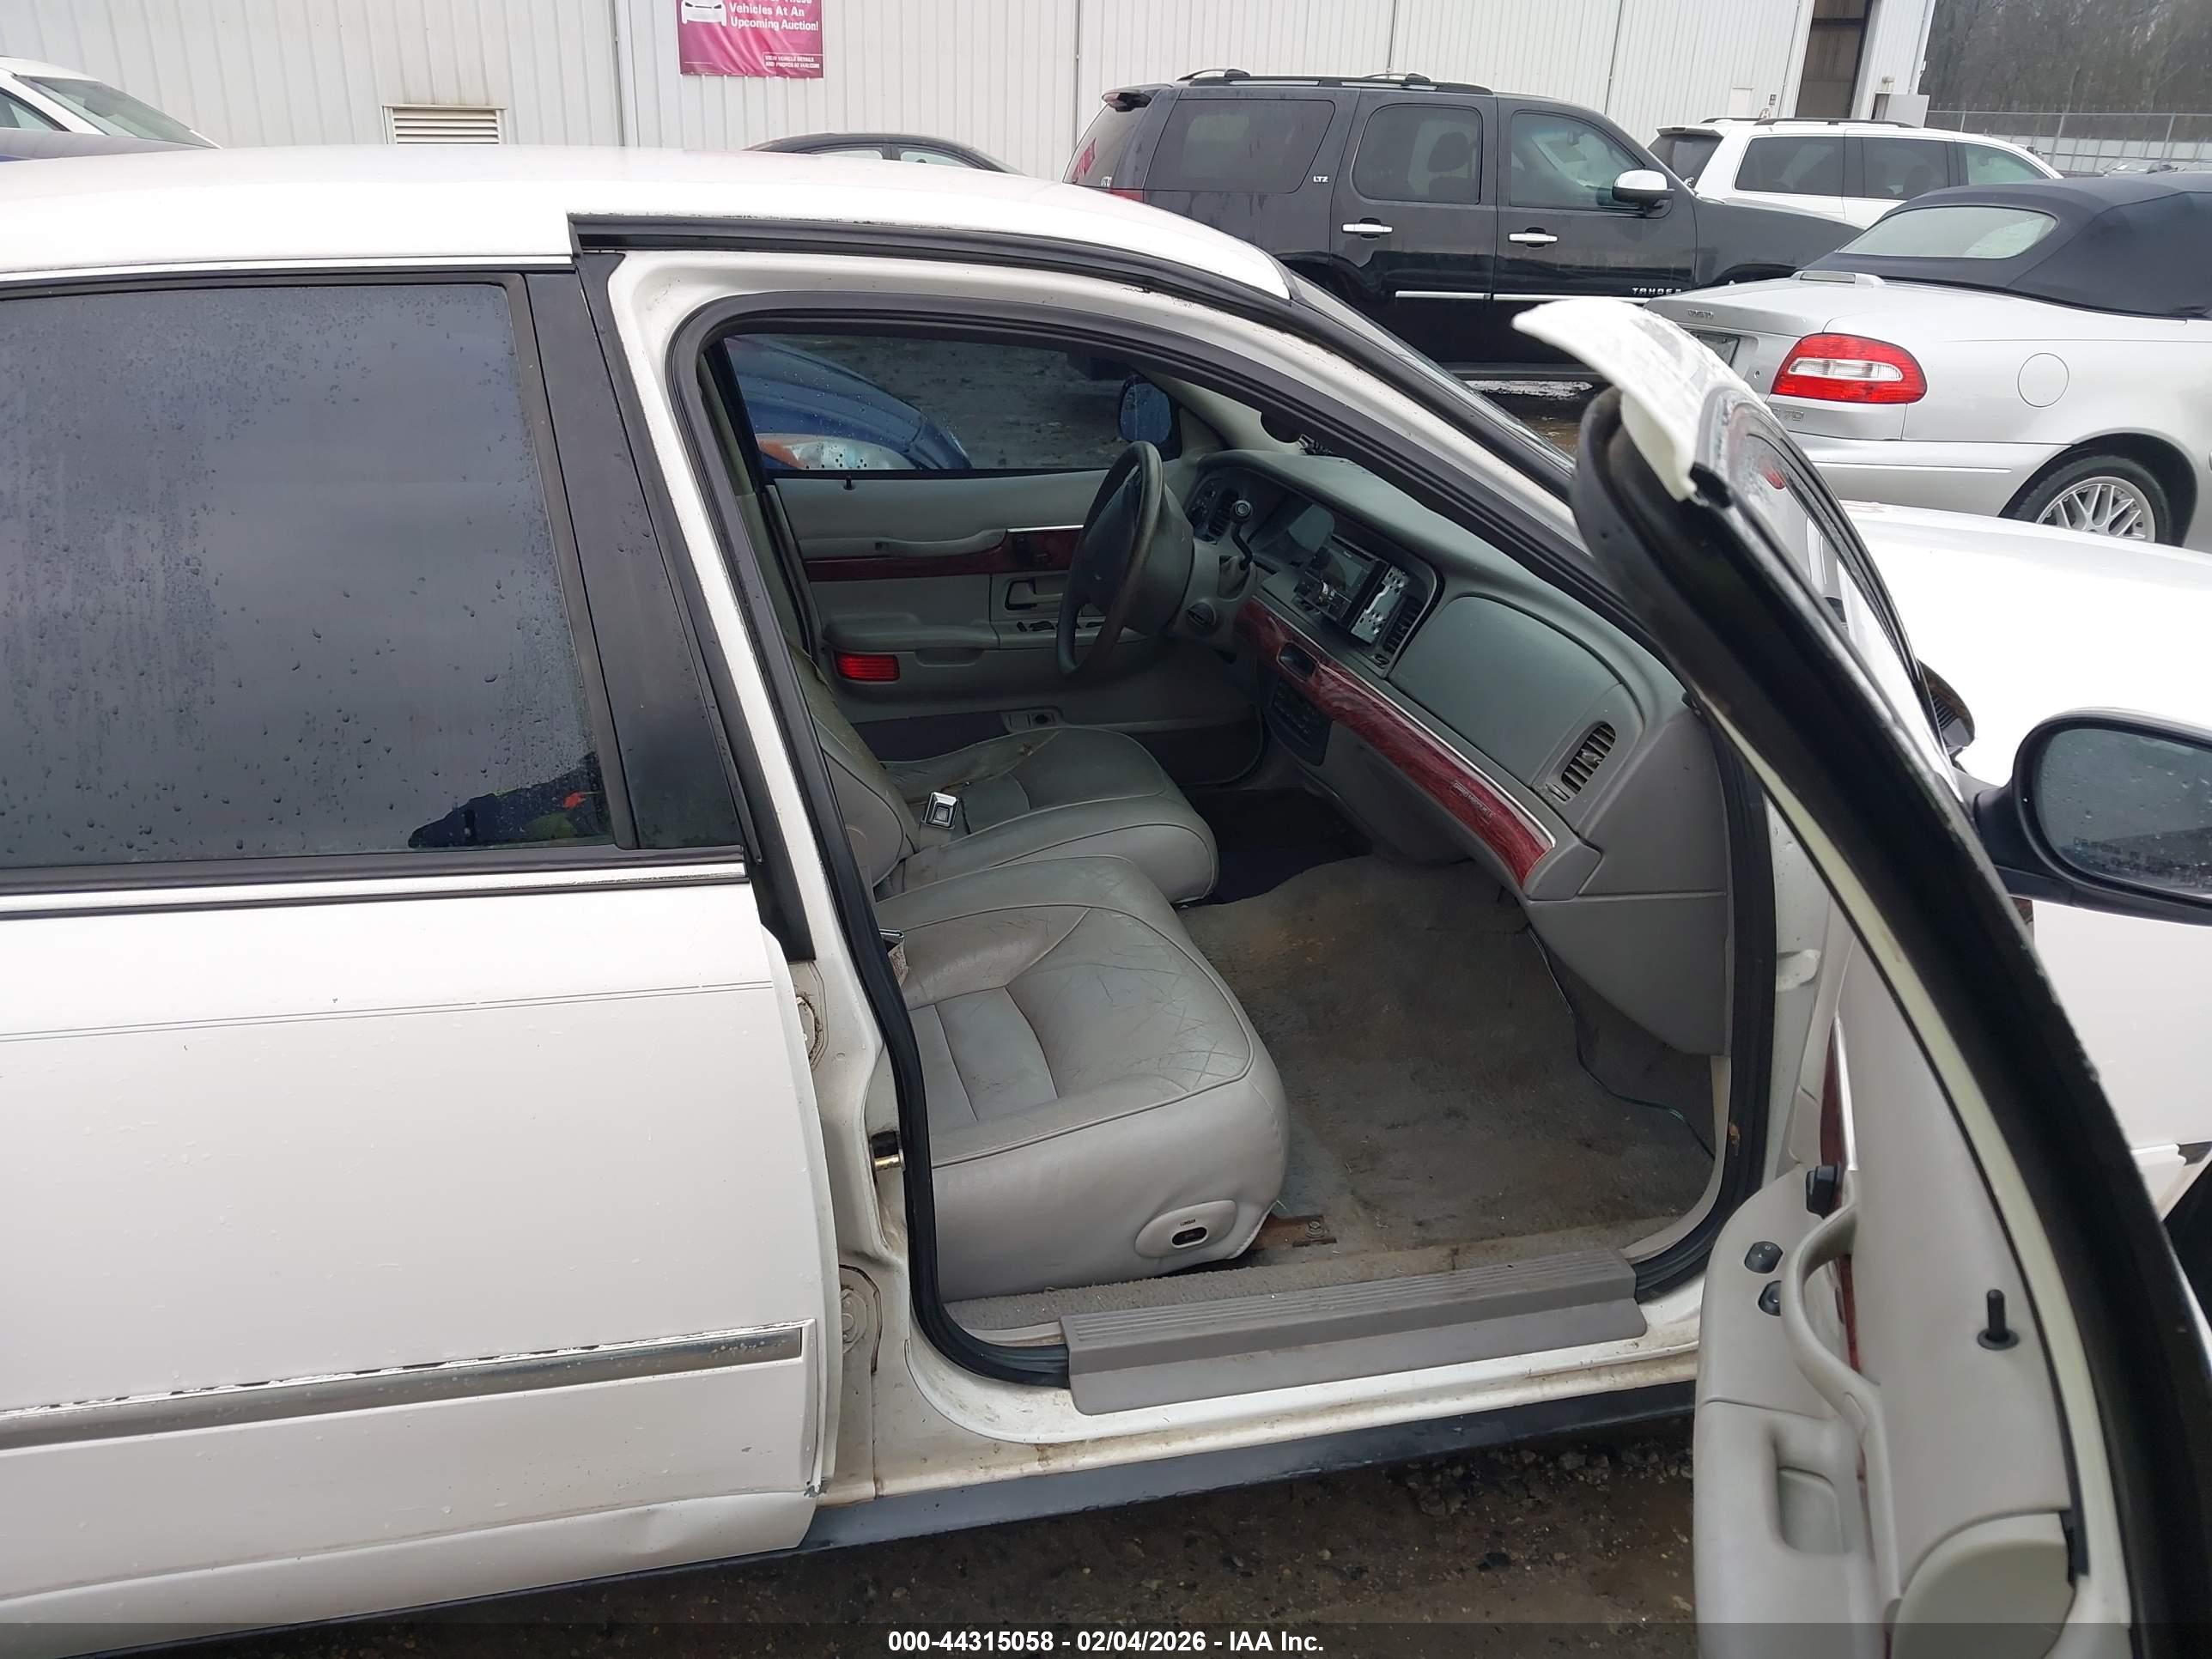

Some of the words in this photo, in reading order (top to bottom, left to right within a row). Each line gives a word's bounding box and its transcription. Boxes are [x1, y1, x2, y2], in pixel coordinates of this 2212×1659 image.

[729, 3, 773, 15] Vehicles
[776, 5, 789, 16] At
[791, 6, 805, 17] An
[731, 15, 780, 31] Upcoming
[781, 19, 818, 31] Auction!
